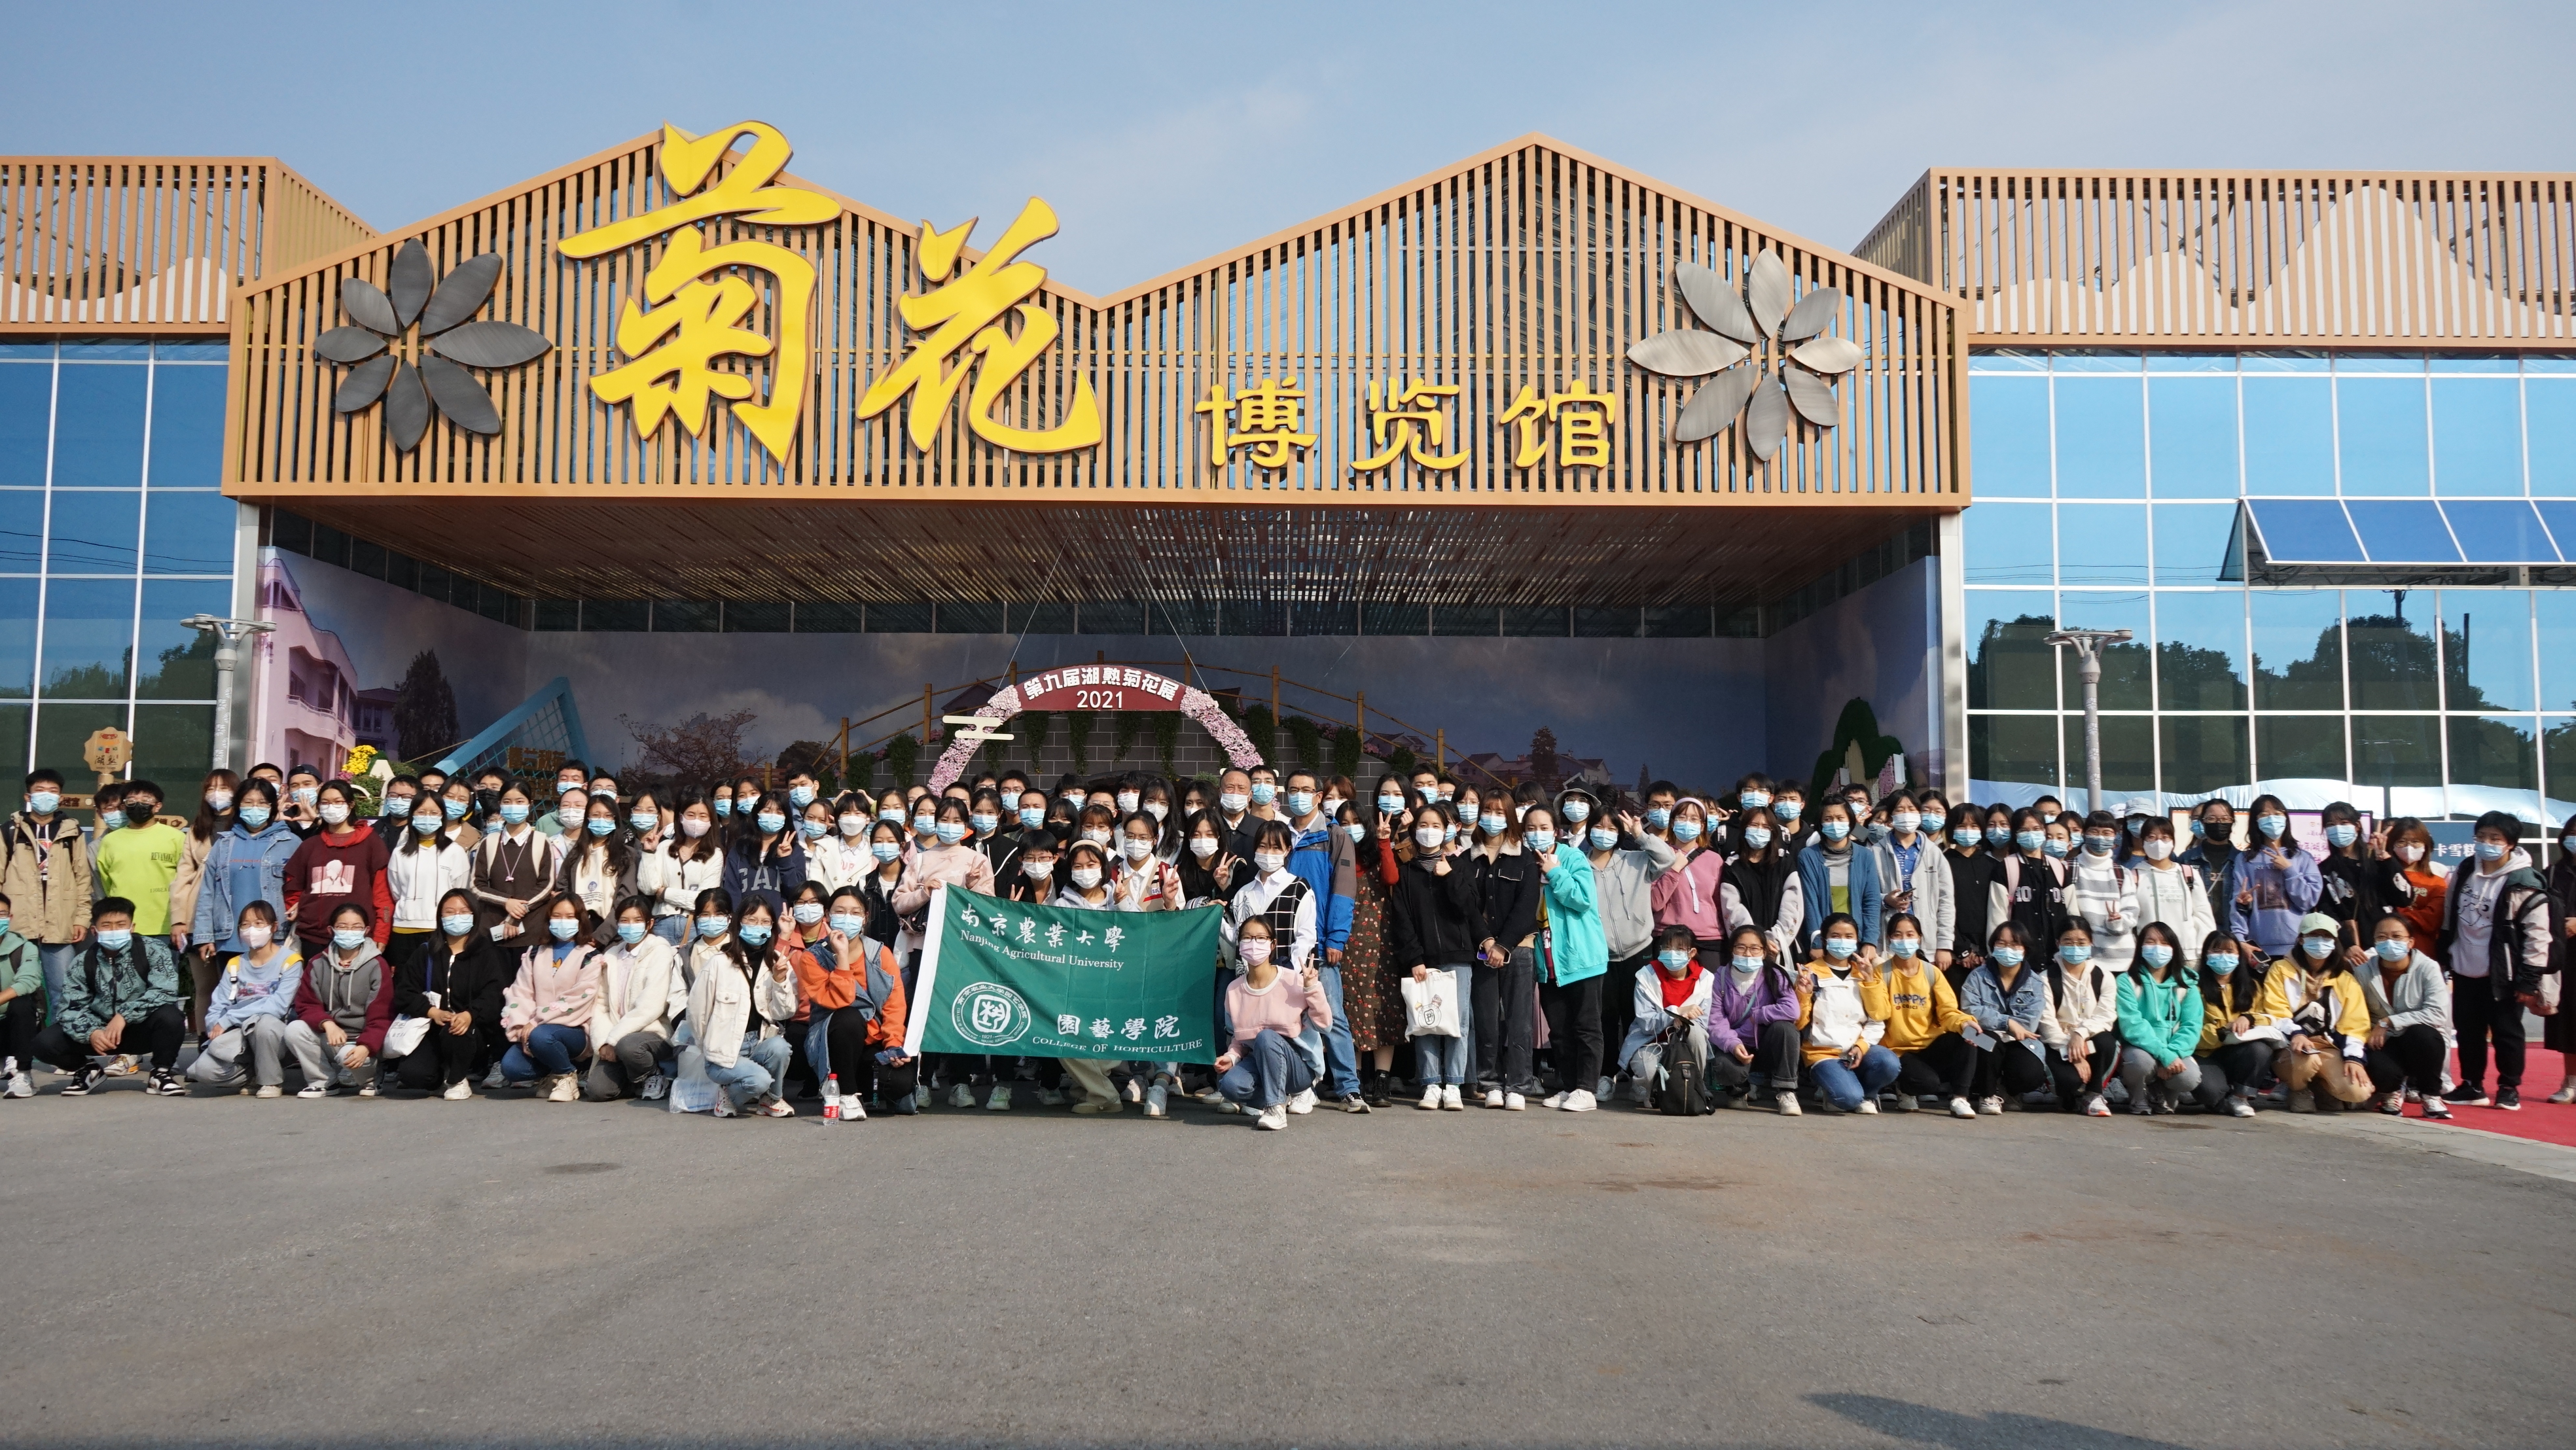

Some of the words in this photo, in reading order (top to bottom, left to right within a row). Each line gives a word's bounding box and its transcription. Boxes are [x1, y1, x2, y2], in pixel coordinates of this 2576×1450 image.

[557, 119, 1103, 467] 菊花
[1195, 376, 1618, 471] 博览馆
[1024, 667, 1179, 701] 第九届湖熟菊花展
[1077, 690, 1122, 709] 2021
[961, 903, 1126, 953] 南京農業大學
[960, 929, 999, 952] Nanjing
[1002, 946, 1065, 964] Agricultural
[1069, 955, 1124, 971] University
[1893, 993, 1927, 1004] HAPPY
[1057, 1014, 1180, 1040] 園藝學院
[1033, 1036, 1086, 1051] COLLEGE
[1092, 1044, 1108, 1053] OF
[1113, 1038, 1202, 1053] HORTICULTURE
